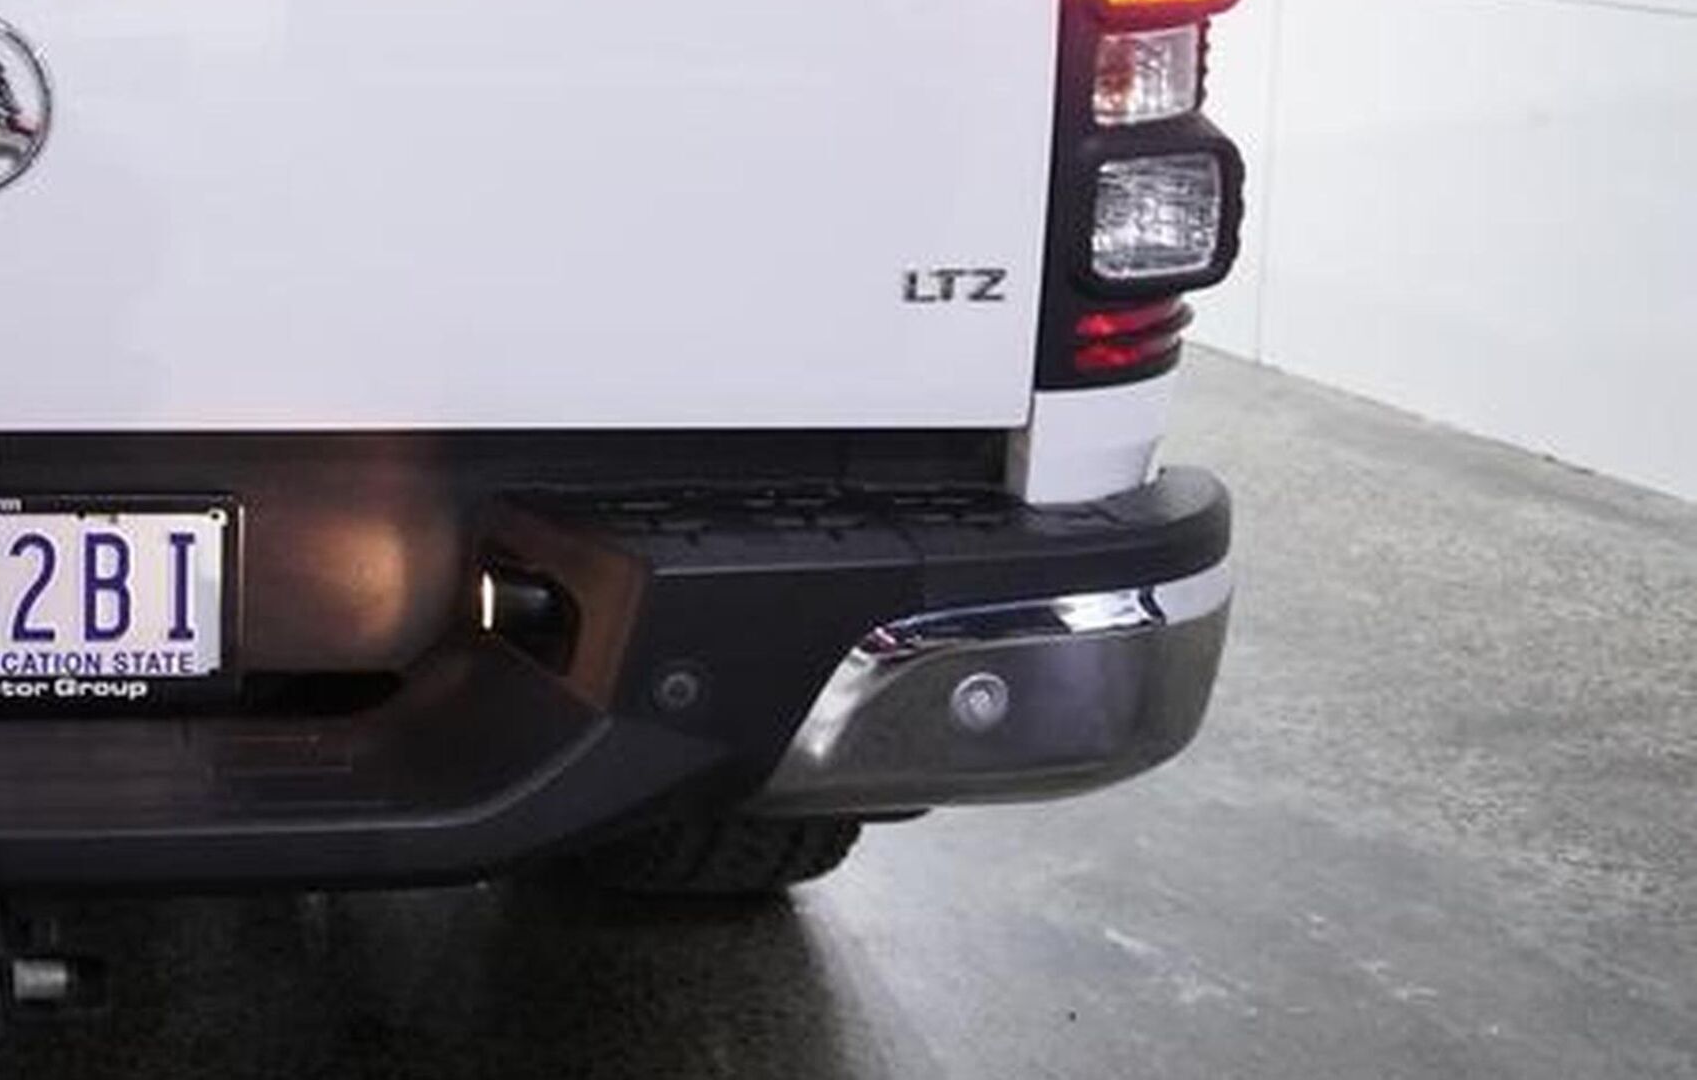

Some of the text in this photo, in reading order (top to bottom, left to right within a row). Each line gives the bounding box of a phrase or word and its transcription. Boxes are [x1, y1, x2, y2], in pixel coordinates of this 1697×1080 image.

[904, 270, 1007, 302] LTZ
[9, 533, 194, 643] 2BI
[114, 652, 194, 674] STATE
[54, 678, 148, 700] Group
